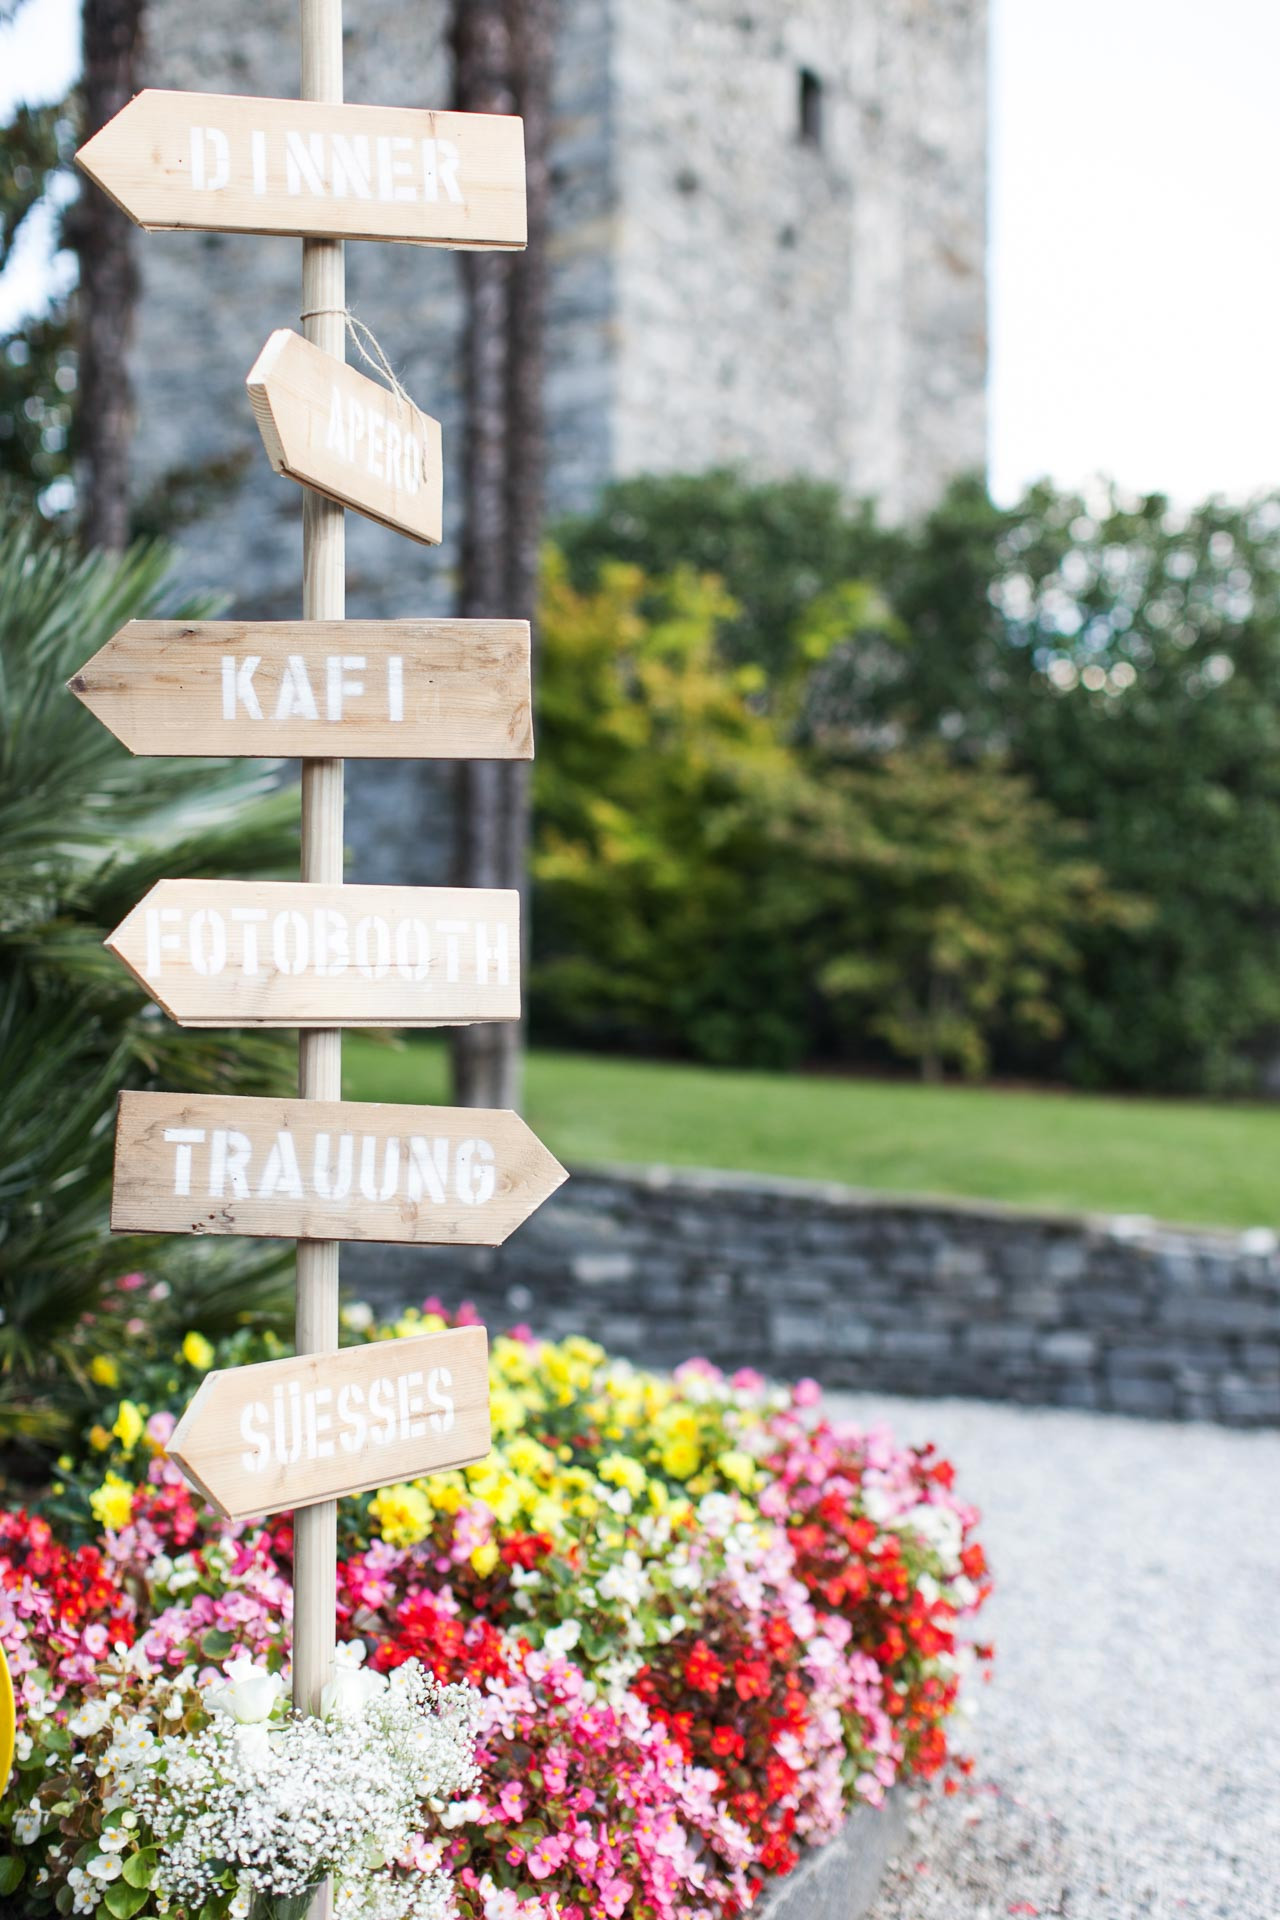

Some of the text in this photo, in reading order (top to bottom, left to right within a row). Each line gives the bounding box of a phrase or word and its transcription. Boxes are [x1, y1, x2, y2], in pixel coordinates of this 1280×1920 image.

[190, 126, 463, 204] DINNER
[326, 384, 421, 496] APERO
[221, 655, 404, 721] KAFI
[145, 908, 510, 985] FOTOBOOTH
[163, 1128, 495, 1205] TRAUUNG
